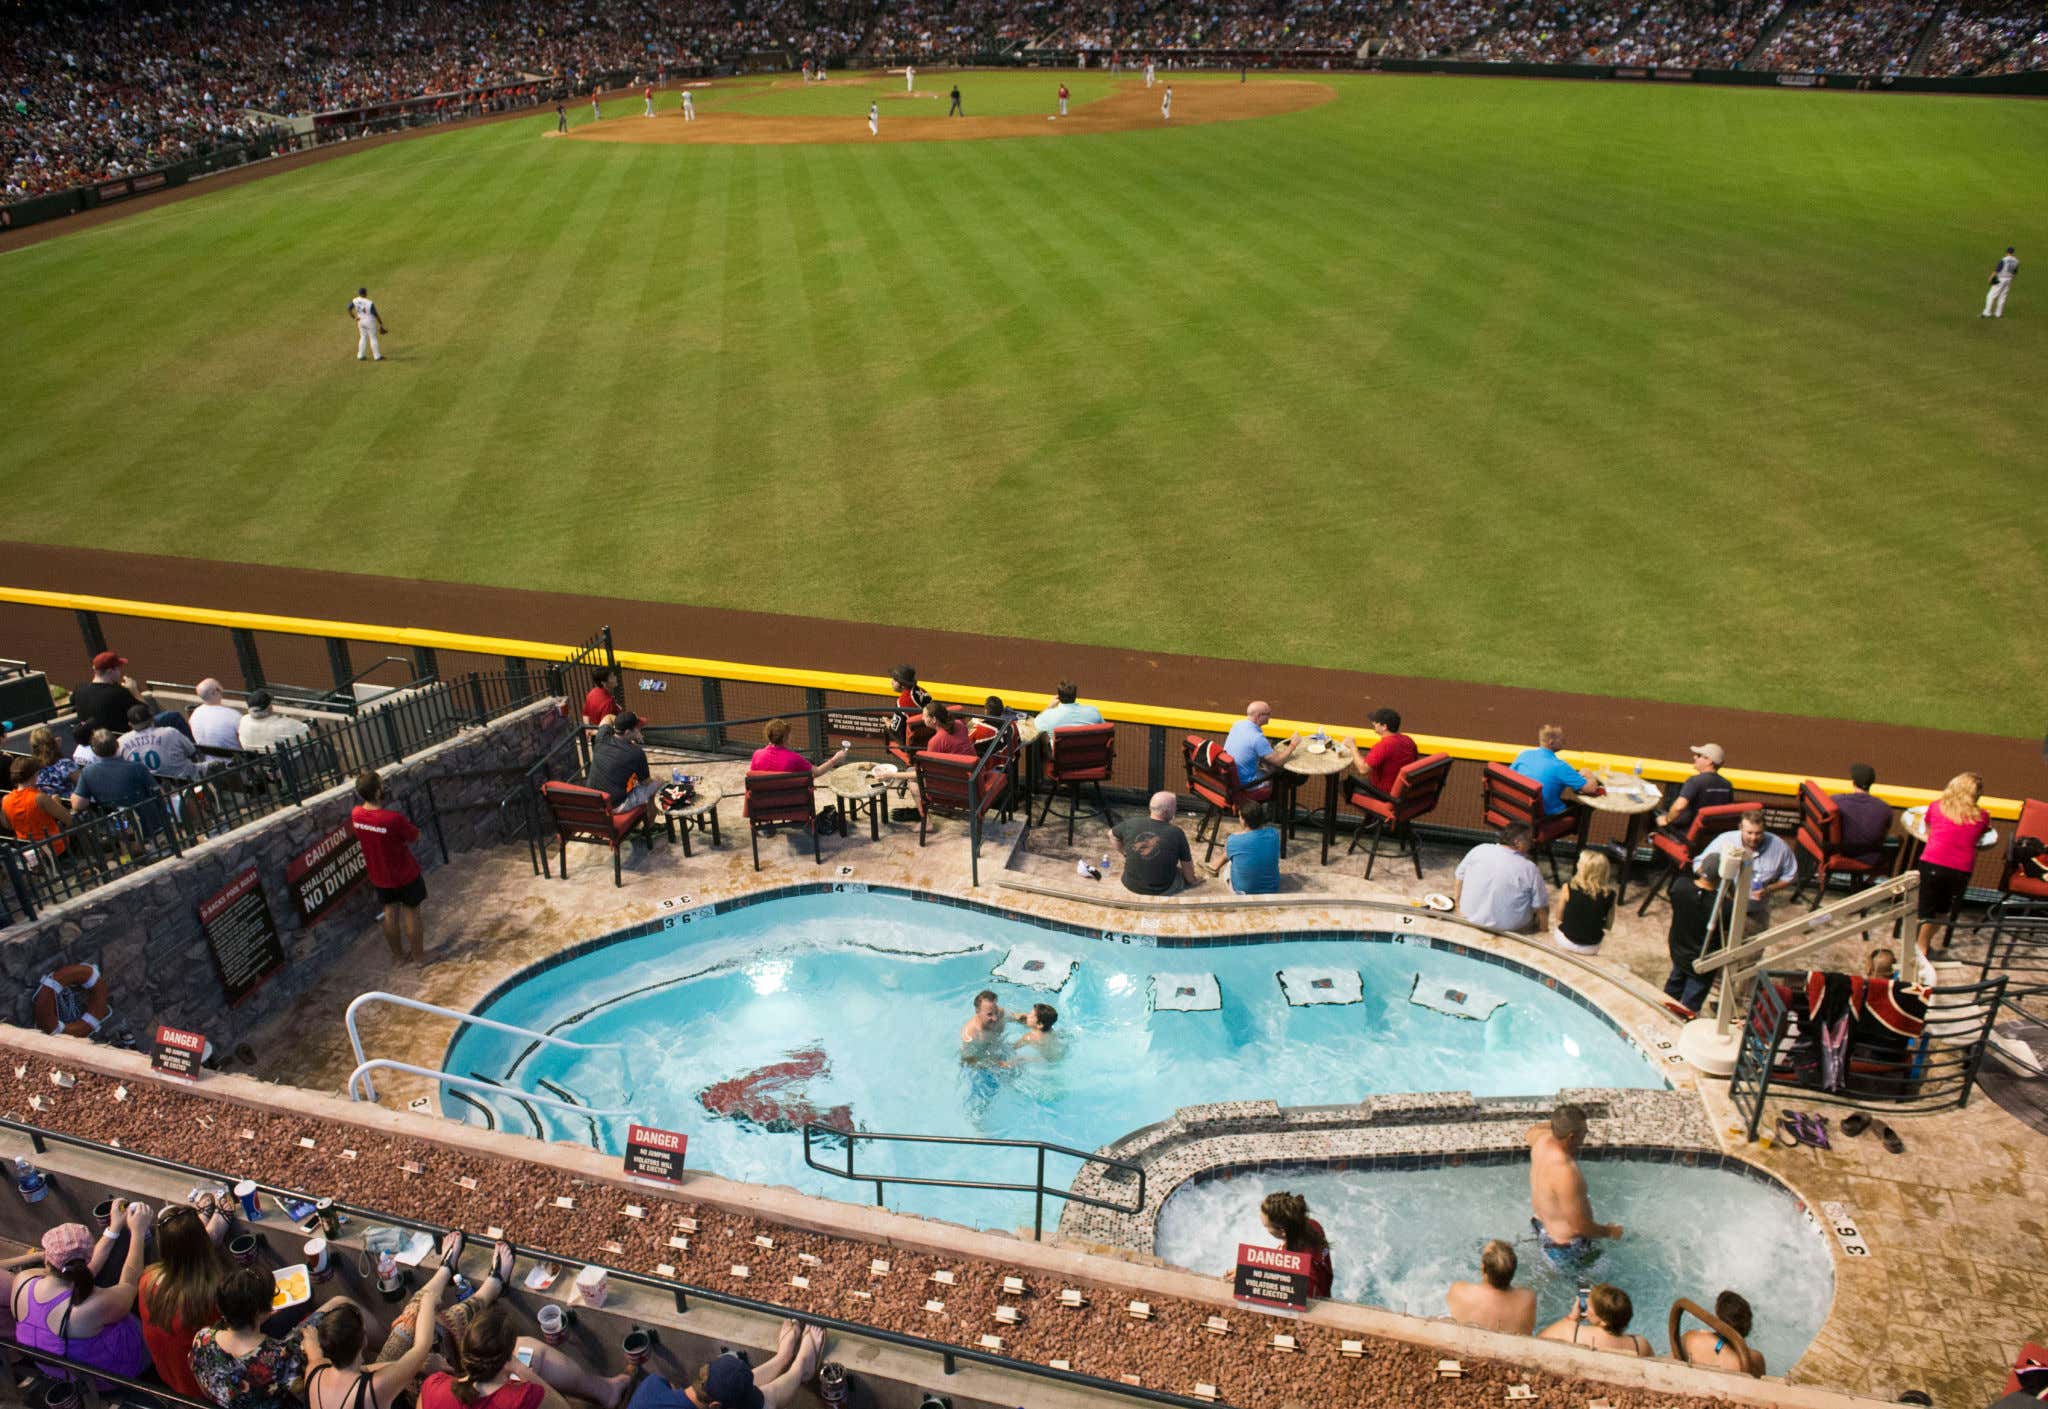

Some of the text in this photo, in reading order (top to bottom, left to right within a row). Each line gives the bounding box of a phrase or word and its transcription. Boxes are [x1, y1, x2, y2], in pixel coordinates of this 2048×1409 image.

[305, 826, 348, 868] CAUTION
[300, 840, 362, 896] SHALLOW WATER
[304, 852, 367, 913] NO DIVING
[163, 1030, 198, 1048] DANGER
[636, 1129, 679, 1149] DANGER
[634, 1156, 672, 1170] VIOLATORS WILL
[648, 1150, 670, 1160] JUMPING
[647, 1165, 667, 1175] EJECTED
[1248, 1248, 1301, 1270] DANGER
[1253, 1270, 1292, 1283] NO JUMPING
[1245, 1278, 1295, 1294] VIOLATORS WILL
[1253, 1287, 1288, 1300] BE EJECTED
